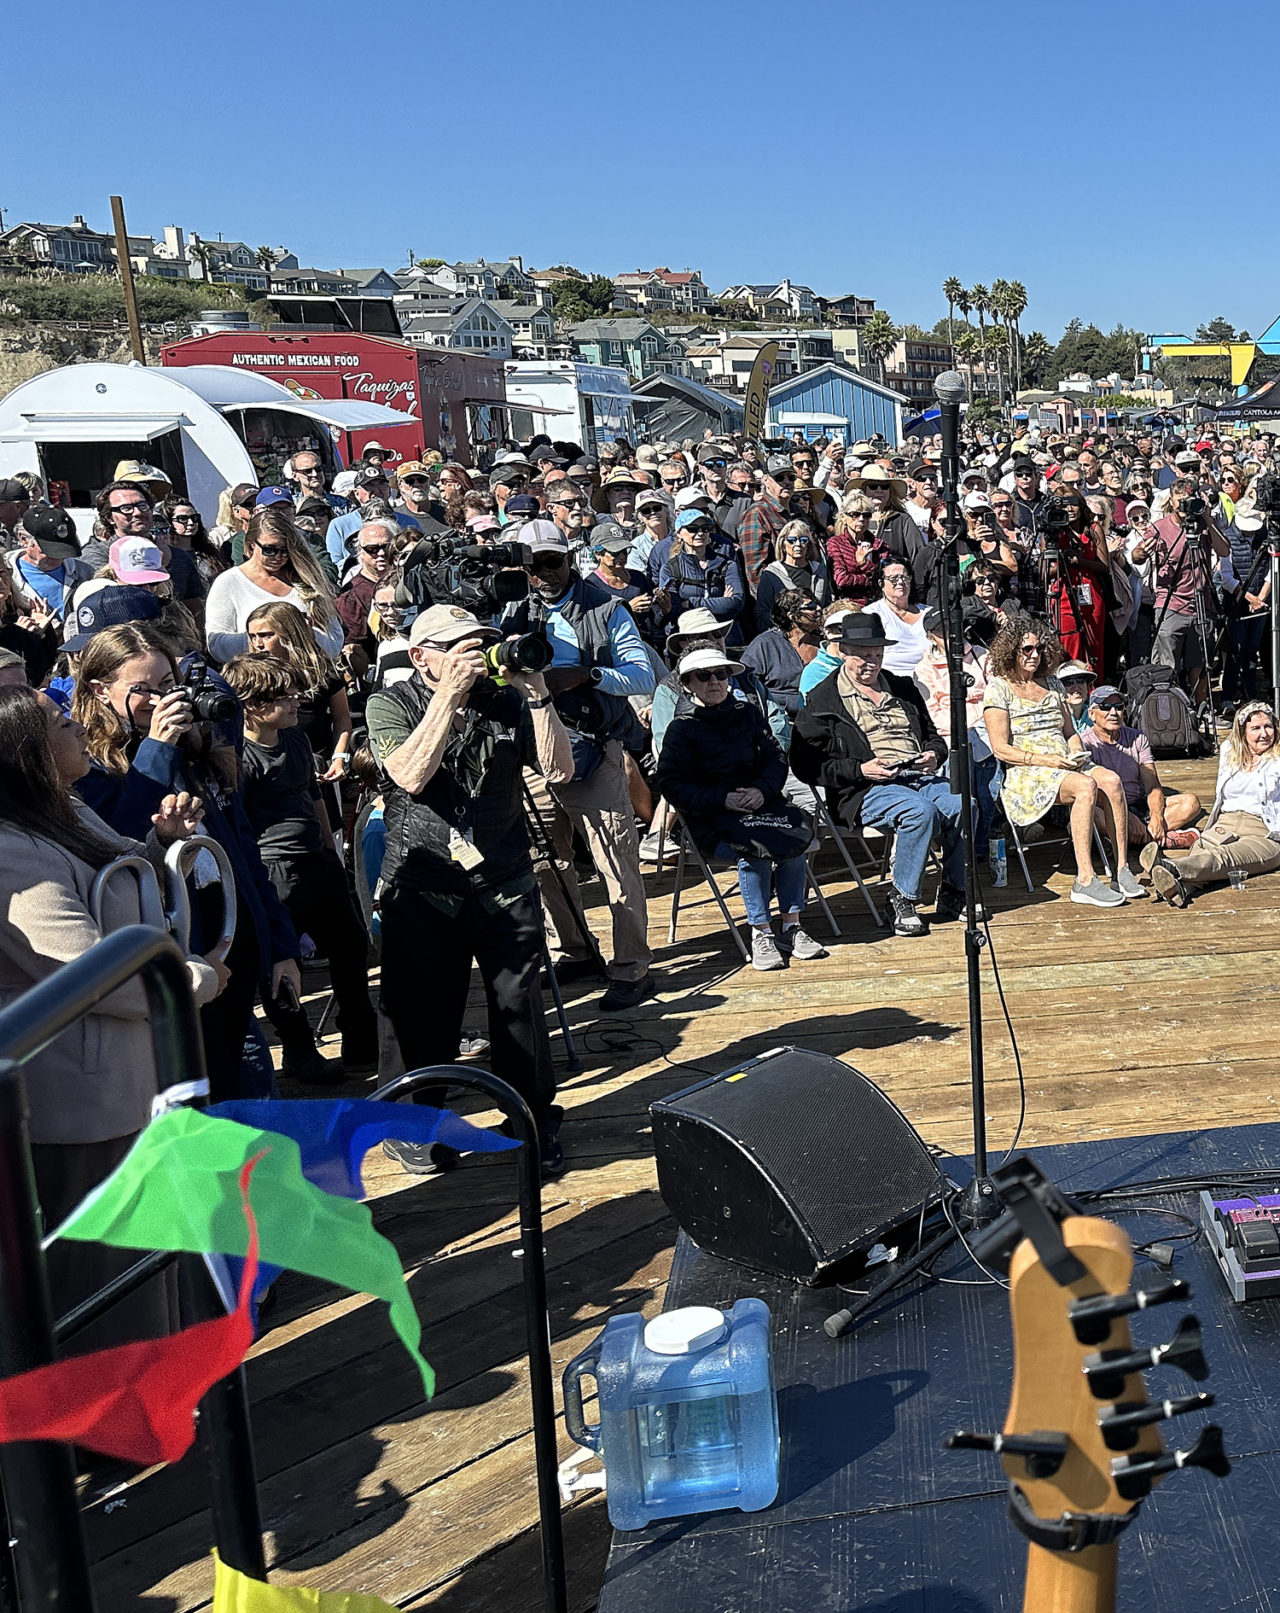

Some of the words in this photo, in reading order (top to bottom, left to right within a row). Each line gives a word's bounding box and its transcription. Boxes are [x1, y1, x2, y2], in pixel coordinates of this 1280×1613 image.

[232, 354, 285, 366] AUTHENTIC
[288, 354, 331, 367] MEXICAN
[334, 355, 360, 367] FOOD
[342, 372, 416, 401] Taquizas
[1243, 408, 1273, 416] CAPITOLA
